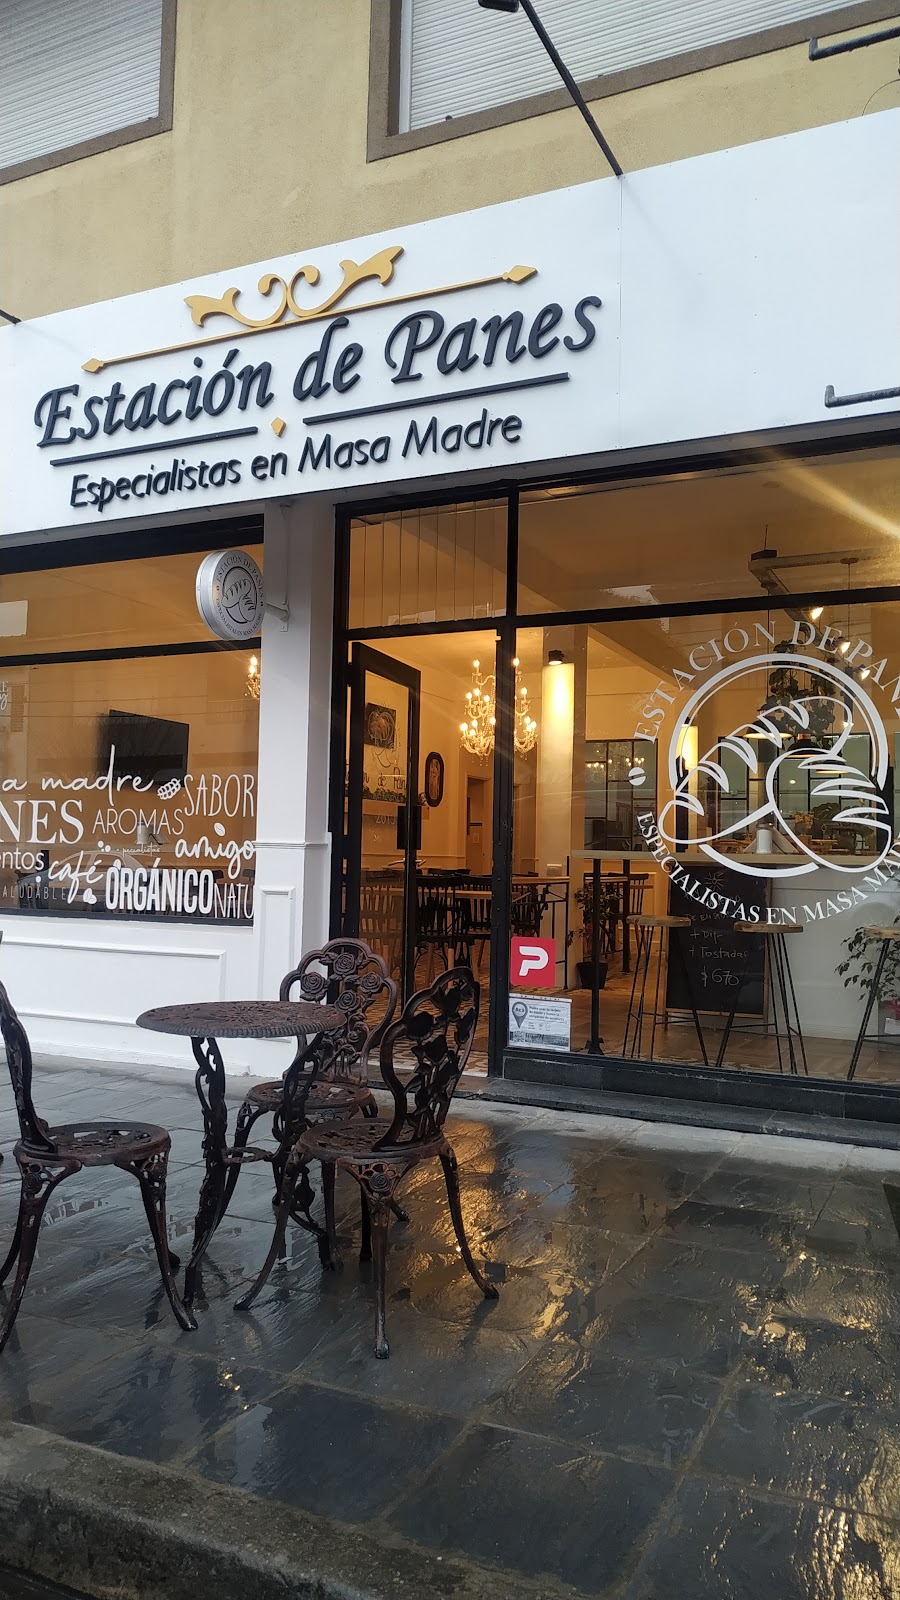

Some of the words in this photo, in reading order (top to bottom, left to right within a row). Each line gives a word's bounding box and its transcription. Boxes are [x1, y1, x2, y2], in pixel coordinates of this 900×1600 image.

[34, 348, 274, 448] Estación
[292, 316, 364, 401] de
[384, 295, 603, 384] Panes
[70, 458, 242, 512] Especialistas
[251, 452, 288, 480] en
[298, 433, 391, 473] Masa
[401, 407, 523, 458] Madre
[633, 620, 776, 744] ESTACIÓN
[790, 620, 843, 652] DE
[843, 638, 900, 719] PAN
[41, 743, 154, 806] madre
[184, 774, 255, 817] SABOR
[92, 808, 184, 835] AROMAS
[0, 847, 45, 870] ntos
[48, 850, 104, 904] café
[105, 857, 214, 914] ORGÁNICO
[175, 835, 256, 879] amigo
[636, 811, 761, 924] ESPECIALISTAS
[766, 906, 797, 925] EN
[801, 886, 869, 923] MASA
